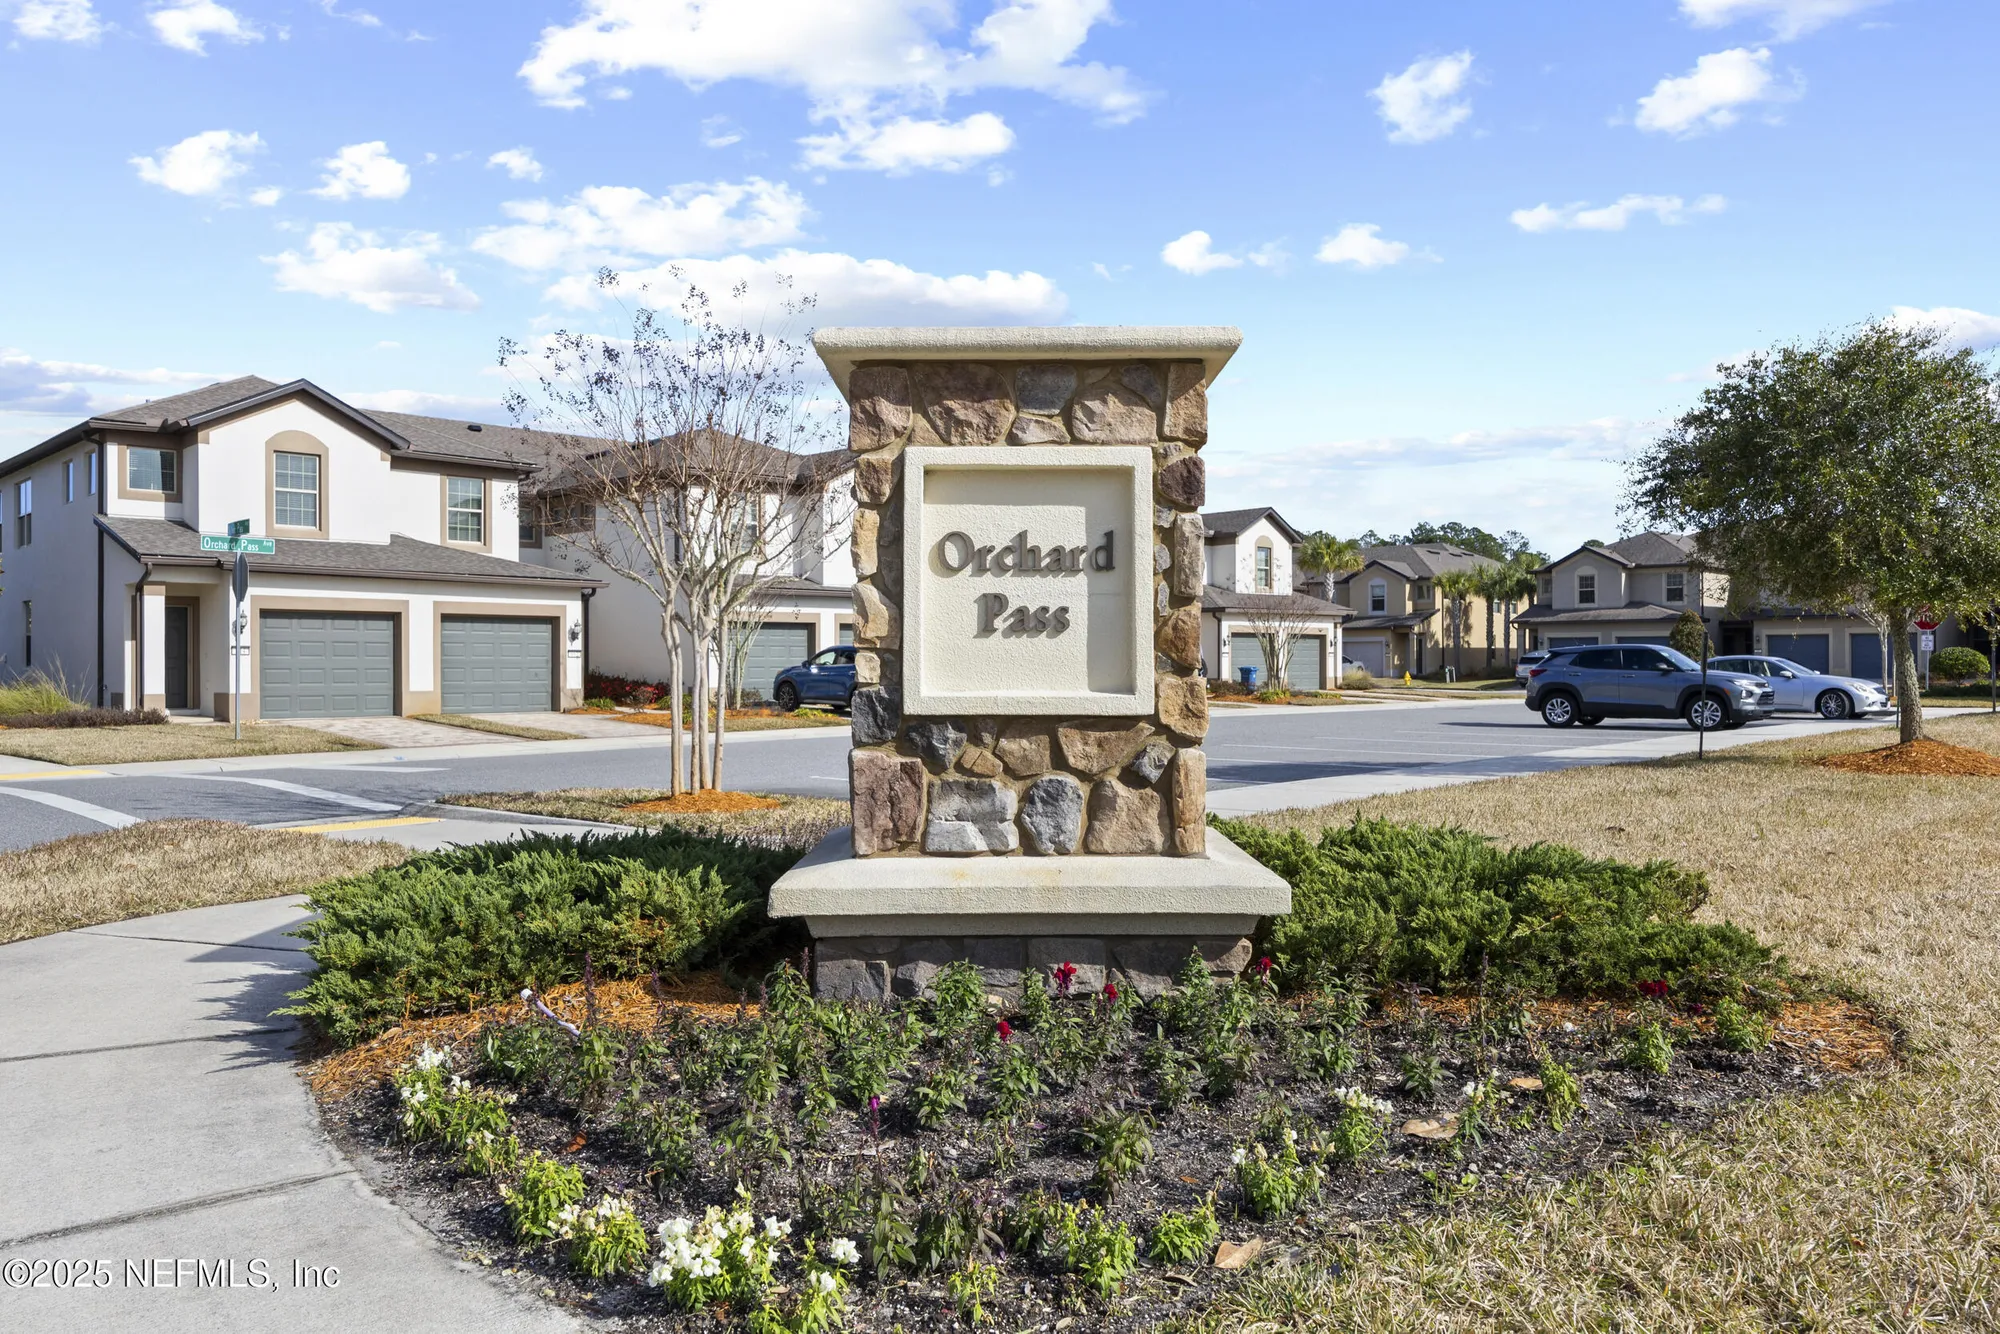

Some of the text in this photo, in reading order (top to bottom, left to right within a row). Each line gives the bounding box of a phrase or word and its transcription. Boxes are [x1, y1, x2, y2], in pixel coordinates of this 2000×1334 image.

[203, 536, 236, 550] Orchard
[241, 539, 259, 551] Pass
[935, 529, 1115, 573] Orchard
[979, 592, 1070, 634] Pass
